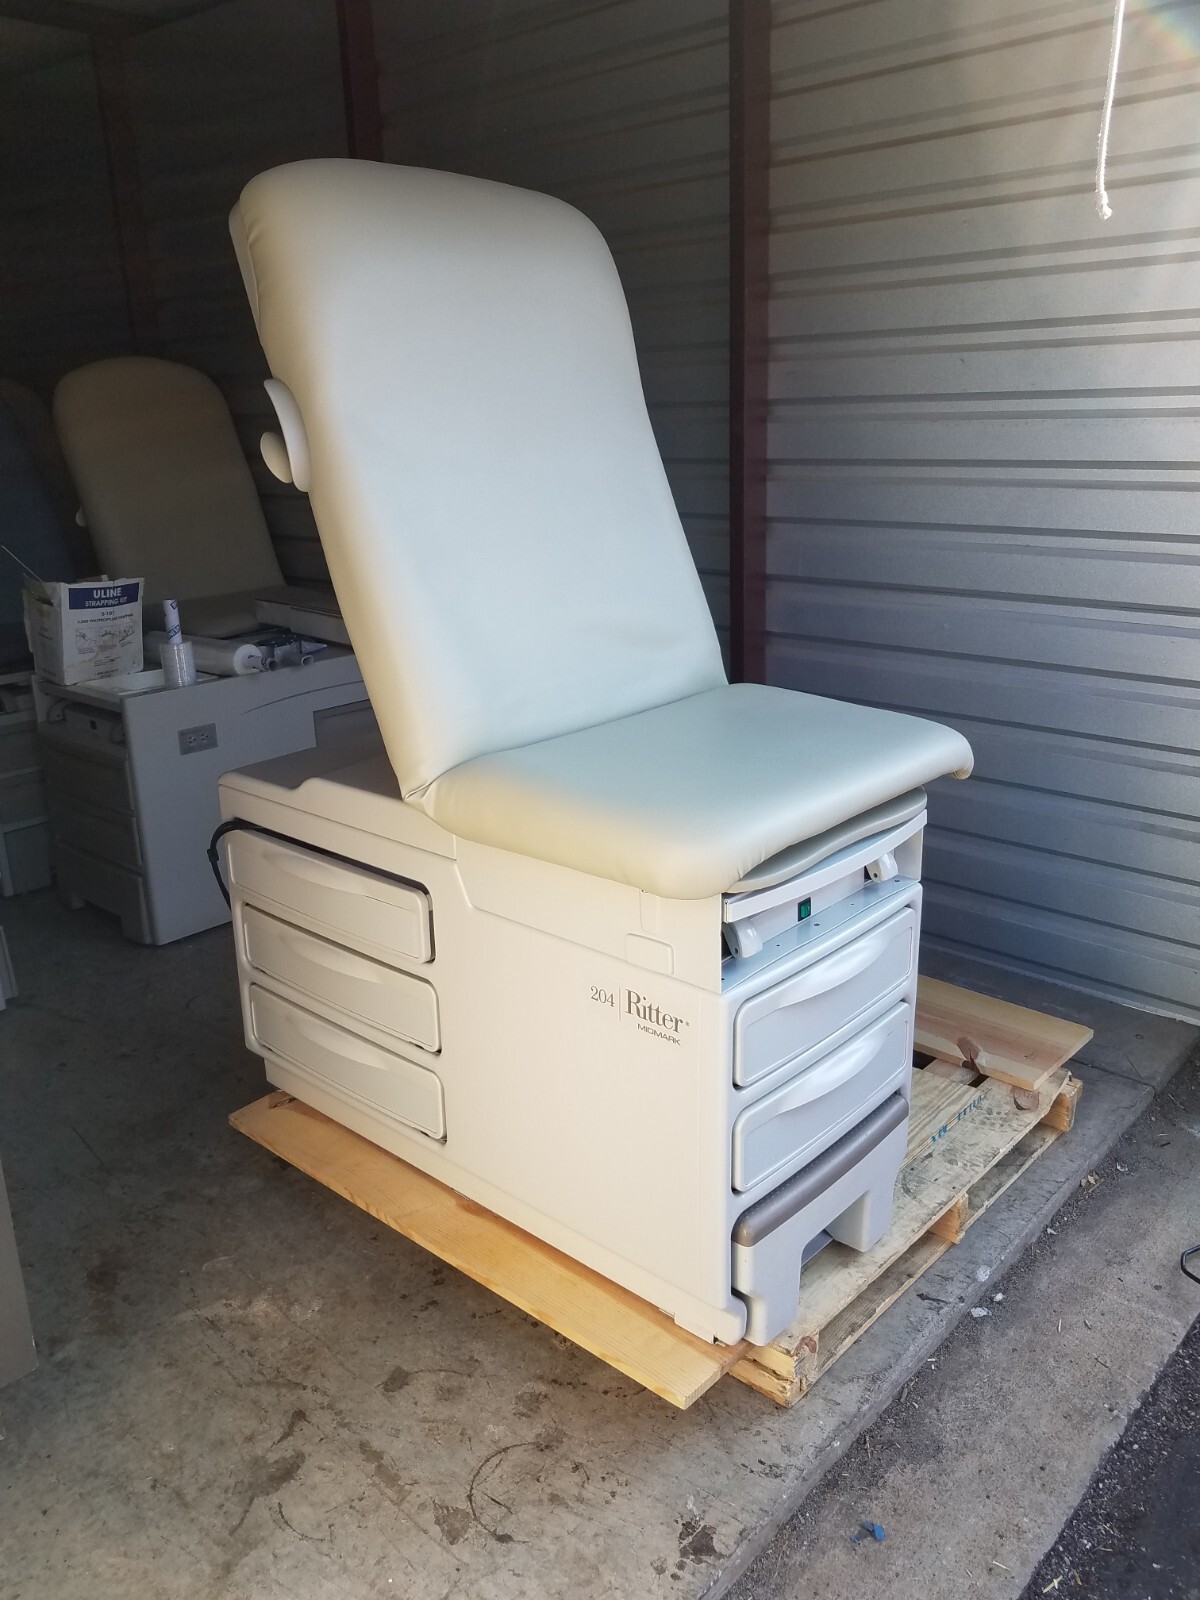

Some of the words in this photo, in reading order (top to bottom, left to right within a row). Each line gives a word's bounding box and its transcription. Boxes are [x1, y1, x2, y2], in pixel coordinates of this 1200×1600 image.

[93, 588, 122, 599] ULINE
[85, 599, 119, 607] STRAPPING
[590, 985, 616, 1008] 204
[624, 988, 684, 1034] Ritter
[637, 1023, 681, 1046] MIDMARK
